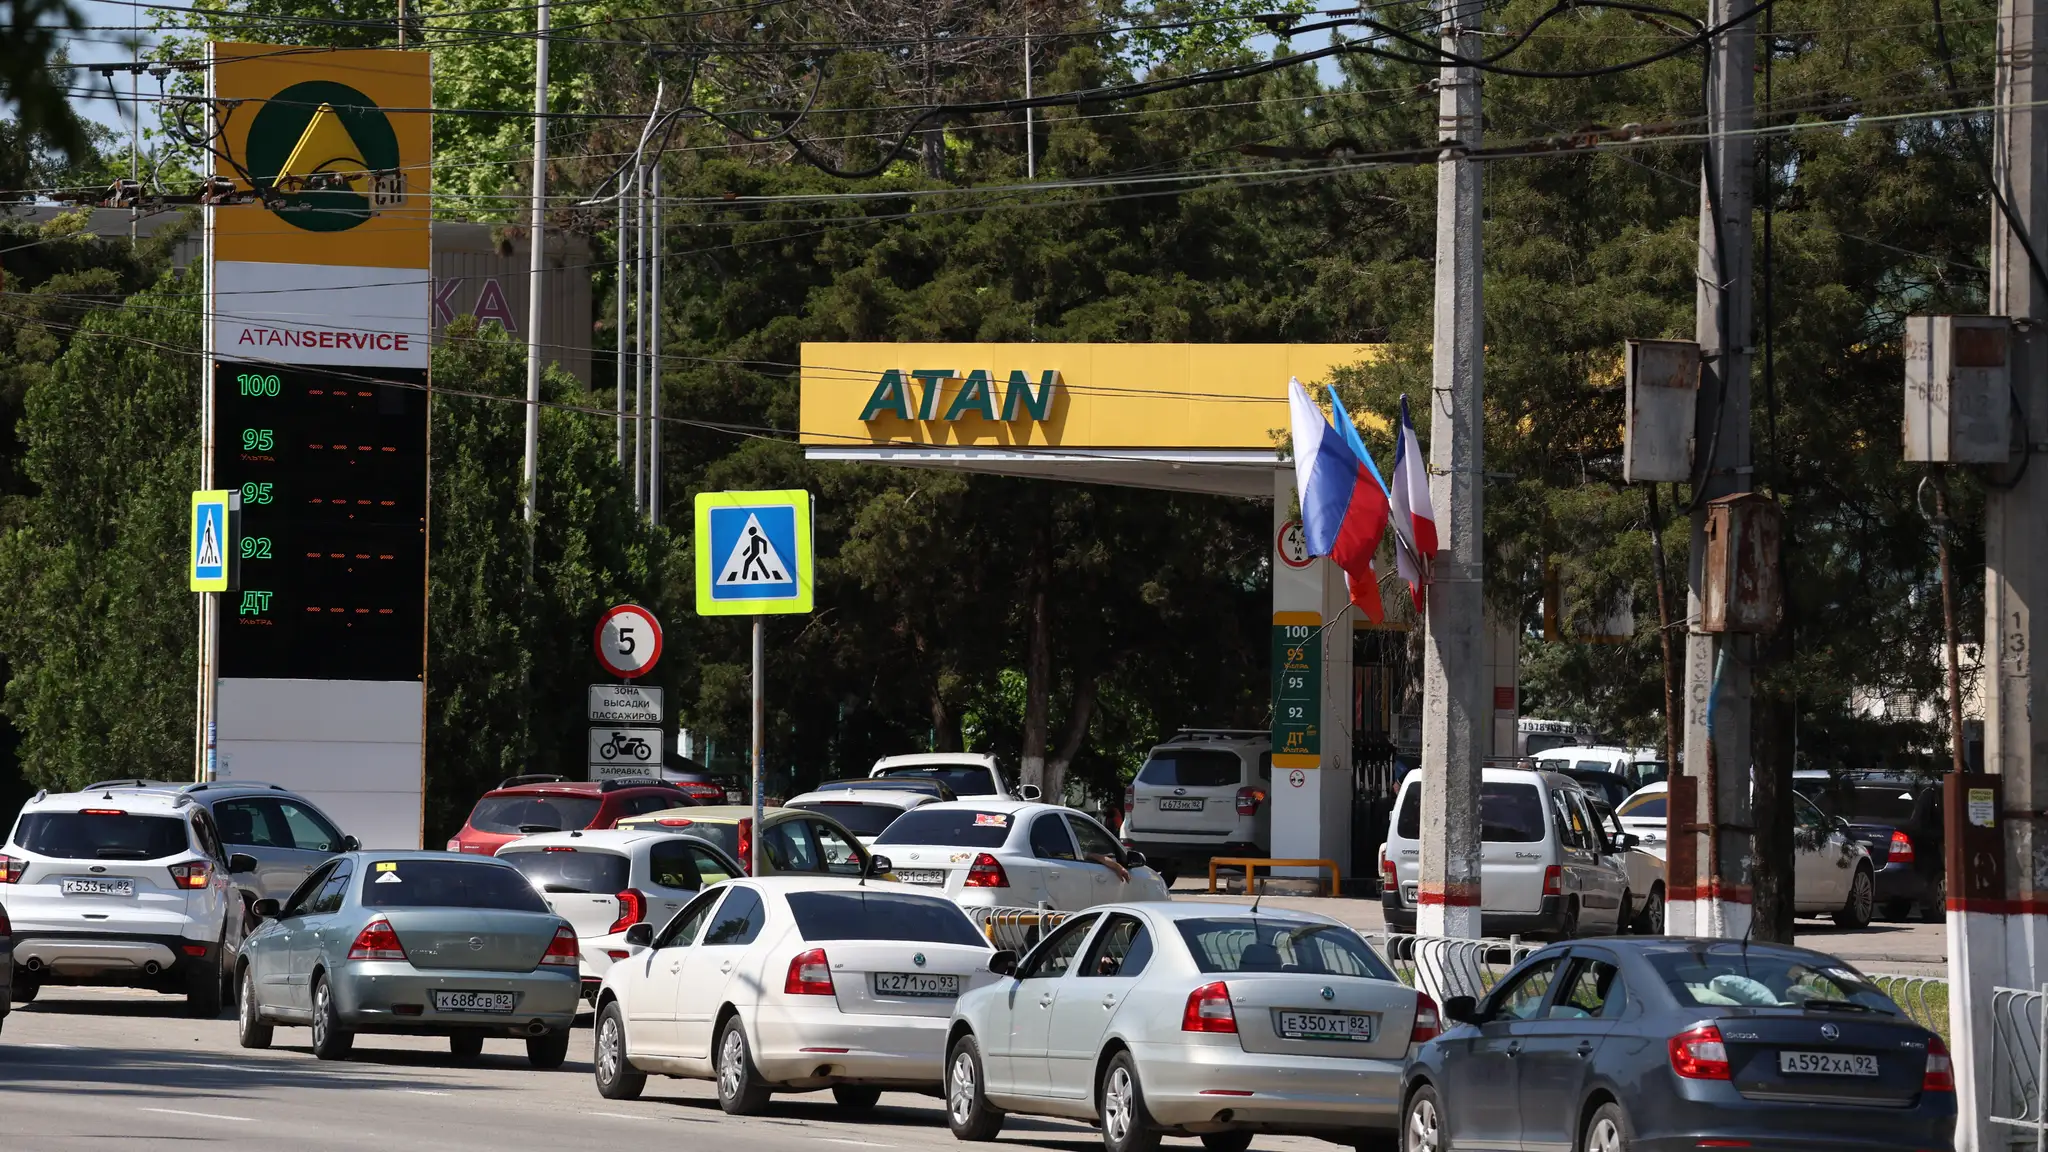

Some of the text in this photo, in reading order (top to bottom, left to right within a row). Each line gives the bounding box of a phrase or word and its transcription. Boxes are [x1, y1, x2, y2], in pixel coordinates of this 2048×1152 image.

[239, 328, 409, 352] ATANSERVICE
[237, 373, 281, 397] 100
[858, 369, 1062, 422] ATAN
[242, 428, 275, 451] 95
[242, 482, 274, 505] 95
[240, 536, 272, 560] 92
[240, 590, 273, 615] ДТ
[1284, 625, 1309, 638] 100
[618, 627, 636, 656] 5
[1287, 648, 1304, 661] 95
[1288, 677, 1304, 689] 95
[614, 687, 640, 696] ЗОНА
[604, 699, 650, 709] ВЫСАДКИ
[592, 711, 658, 722] ПАССАЖИРОВ
[1288, 706, 1304, 719] 92
[1286, 731, 1304, 746] ДТ
[600, 767, 642, 776] ЗАПРАВКА
[898, 870, 941, 882] 851СЕ 82
[67, 880, 130, 893] К533ЕК 82
[881, 974, 954, 992] К271УО 93
[441, 993, 509, 1008] К688СВ 82
[1288, 1015, 1365, 1033] Е350ХТ 82
[1788, 1054, 1873, 1073] А592ХА 92
